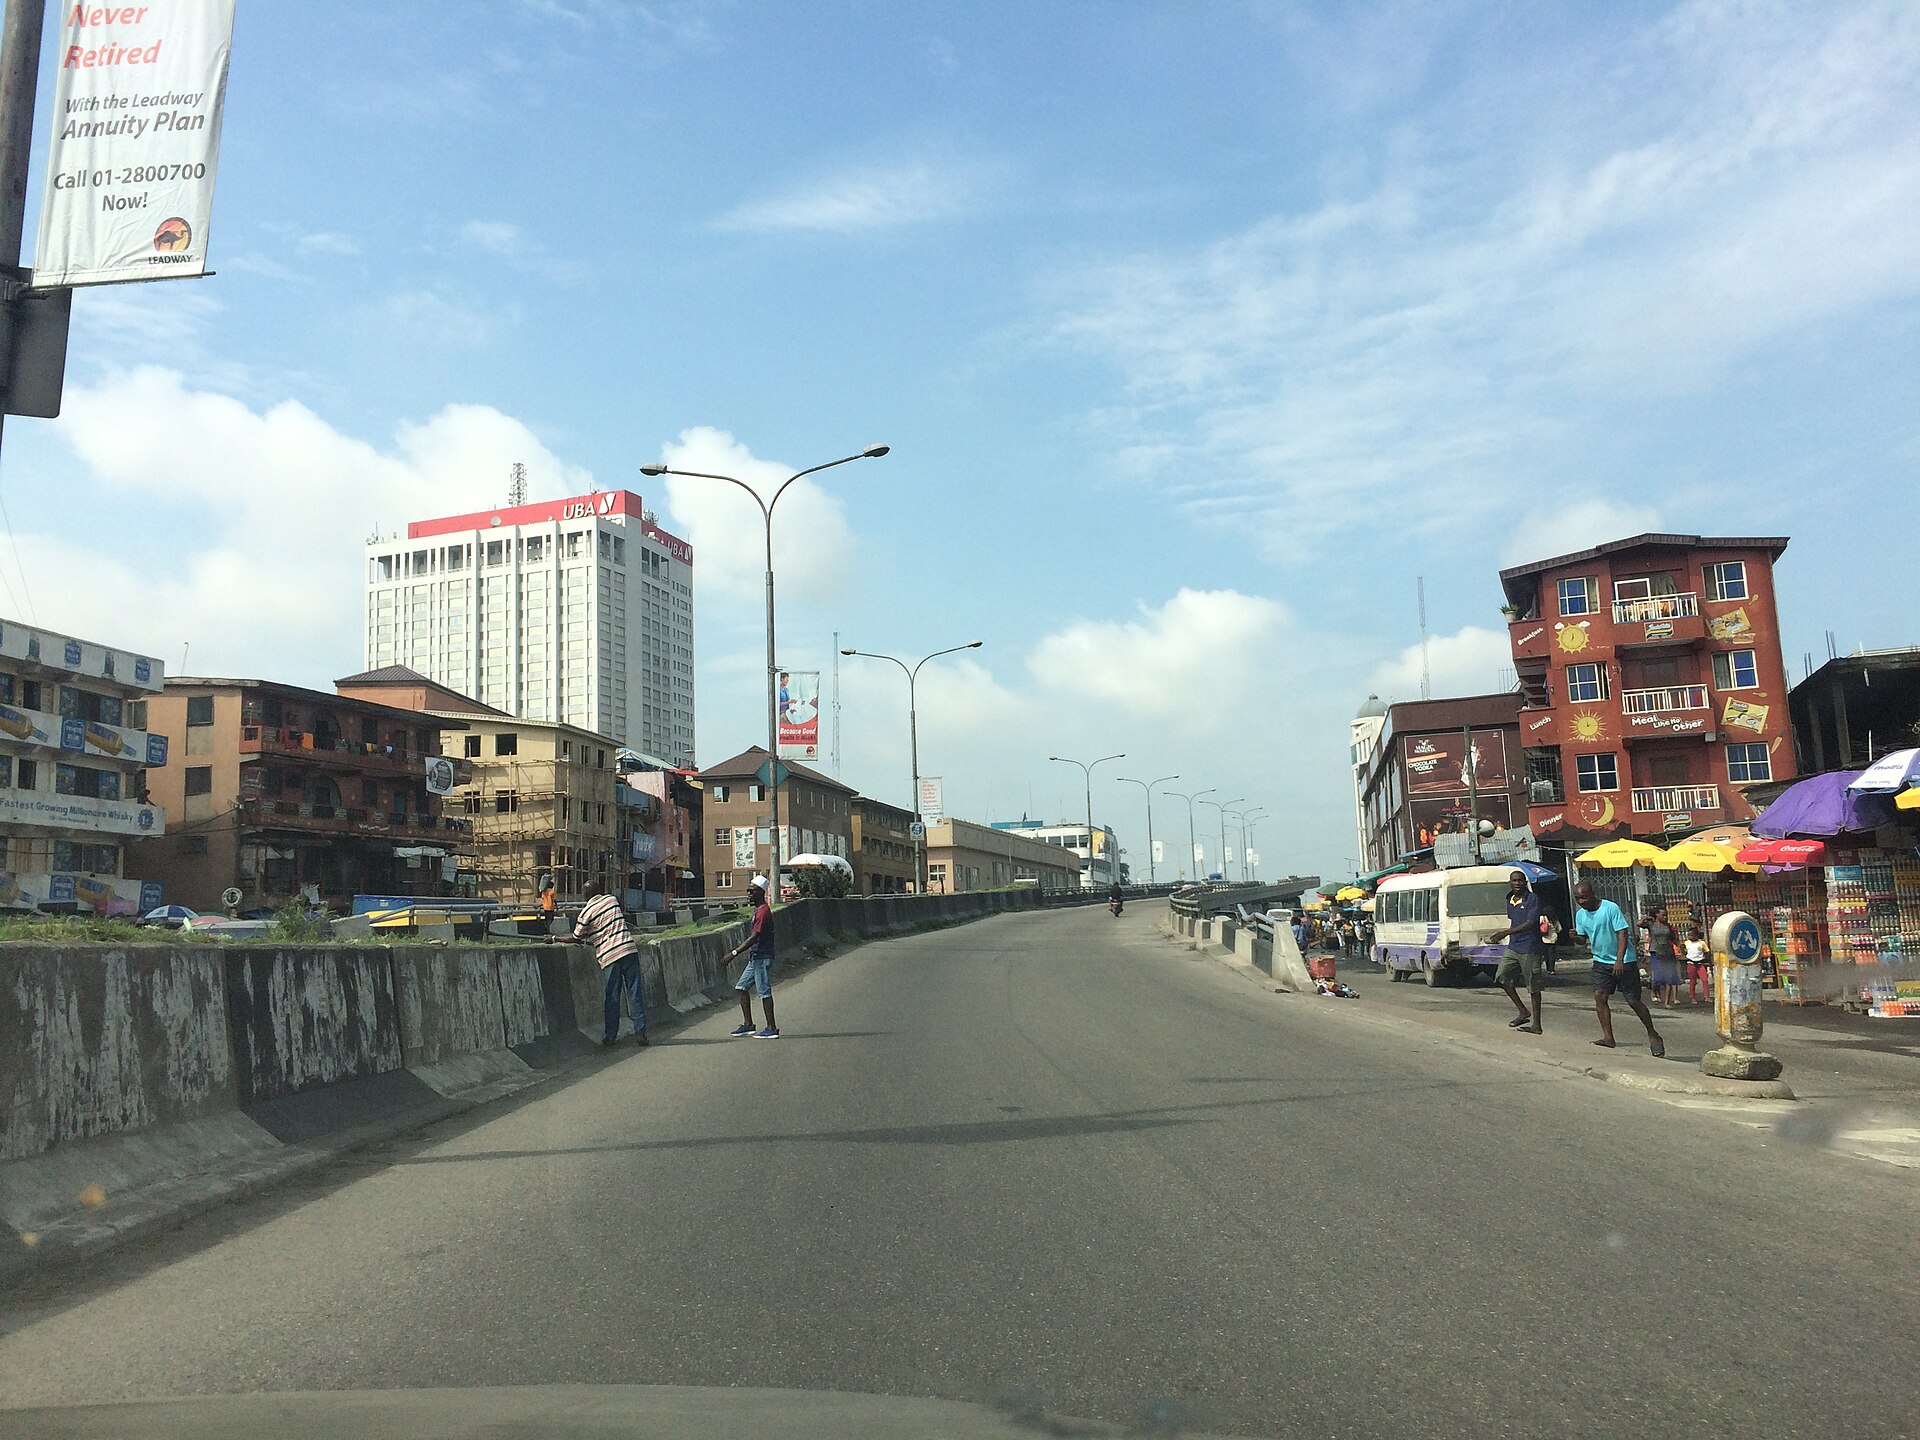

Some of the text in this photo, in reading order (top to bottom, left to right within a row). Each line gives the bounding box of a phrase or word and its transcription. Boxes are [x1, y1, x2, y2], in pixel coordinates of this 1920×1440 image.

[67, 4, 149, 28] Never
[63, 39, 162, 69] Retired
[66, 91, 204, 113] With the Leadway
[60, 110, 205, 140] Annuity Plan
[53, 162, 206, 190] Call 01-2800700
[102, 191, 149, 211] Now!
[148, 254, 194, 265] LEADWAY
[562, 501, 596, 520] UBA
[667, 540, 684, 558] UBA
[1528, 716, 1552, 731] Lunch
[1631, 714, 1658, 726] Meal
[1672, 719, 1704, 731] Other
[779, 727, 802, 735] Because
[36, 801, 68, 816] Growing
[108, 810, 134, 824] Whisky
[1539, 813, 1564, 828] Dinner
